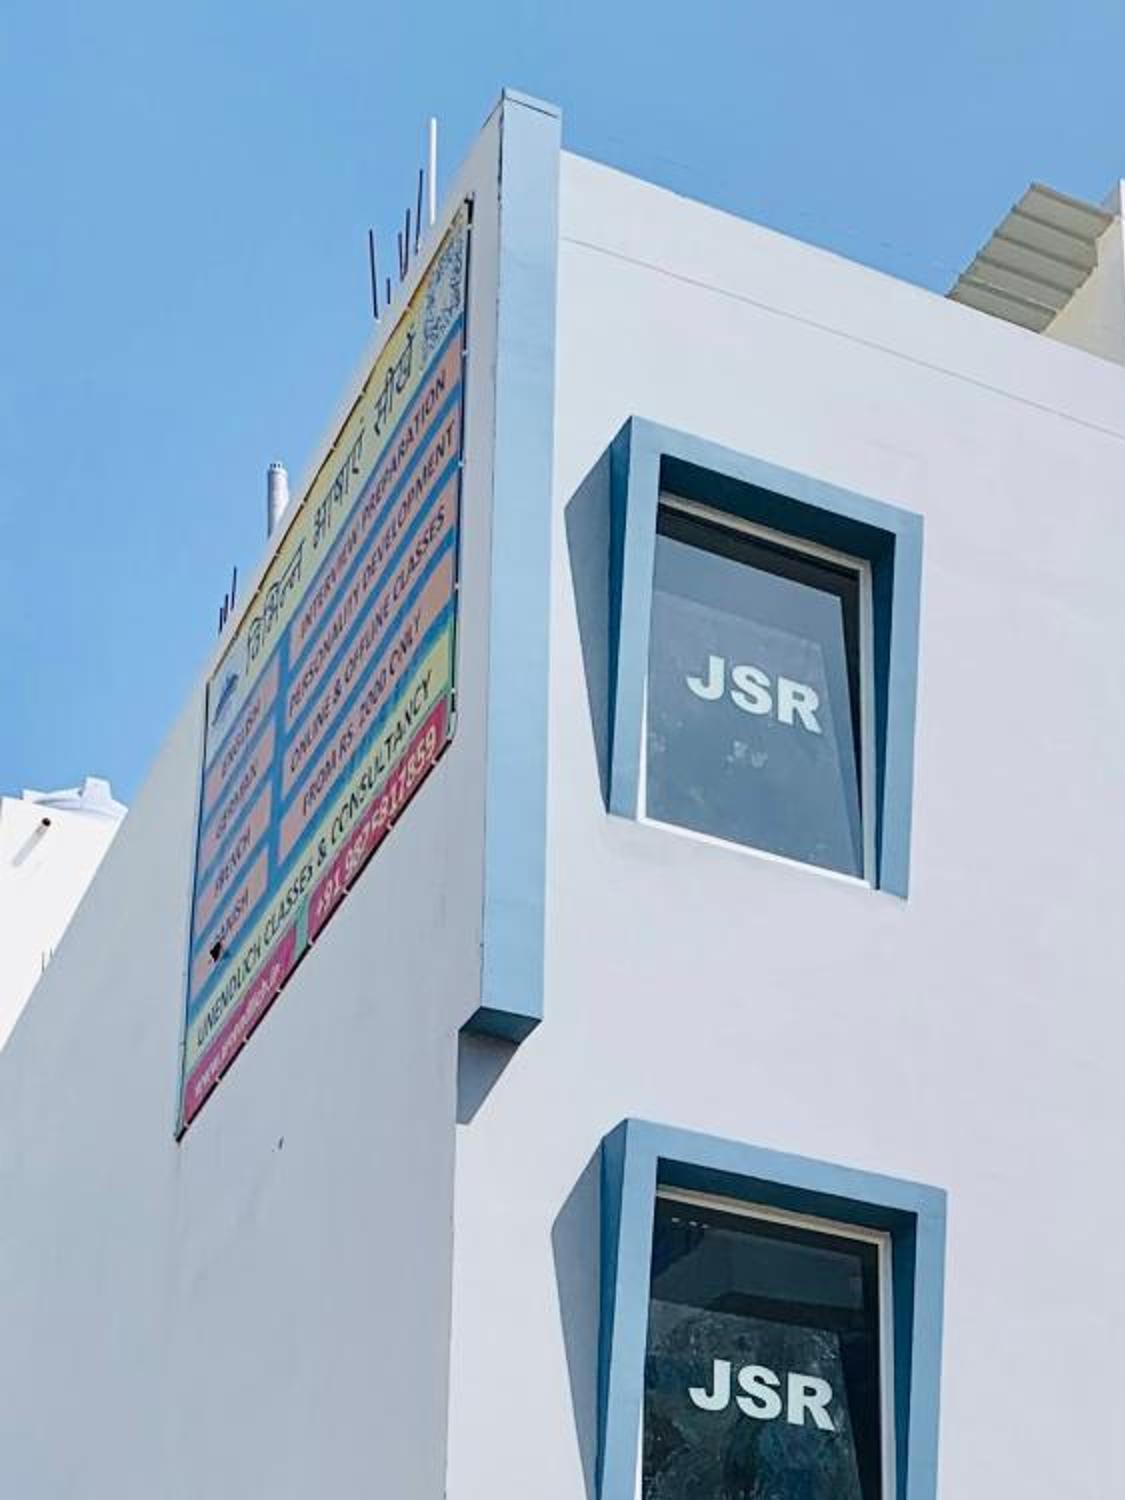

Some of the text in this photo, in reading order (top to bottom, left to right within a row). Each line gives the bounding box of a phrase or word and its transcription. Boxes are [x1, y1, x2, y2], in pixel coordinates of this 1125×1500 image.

[289, 418, 455, 719] PERSONALITY DEVELOPMENT
[300, 369, 447, 641] INTERVIEW PREPARATION
[289, 697, 331, 775] ONLINE
[344, 600, 389, 684] OFFLINE
[392, 503, 446, 602] CLASSES
[302, 751, 337, 818] FROM
[388, 608, 422, 677] ONLY
[686, 655, 822, 734] JSR
[197, 940, 262, 1047] UNENDLICH
[263, 861, 314, 946] CLASSES
[331, 668, 433, 845] CONSULTANCY
[316, 868, 342, 917] +91
[688, 1358, 836, 1432] JSR
